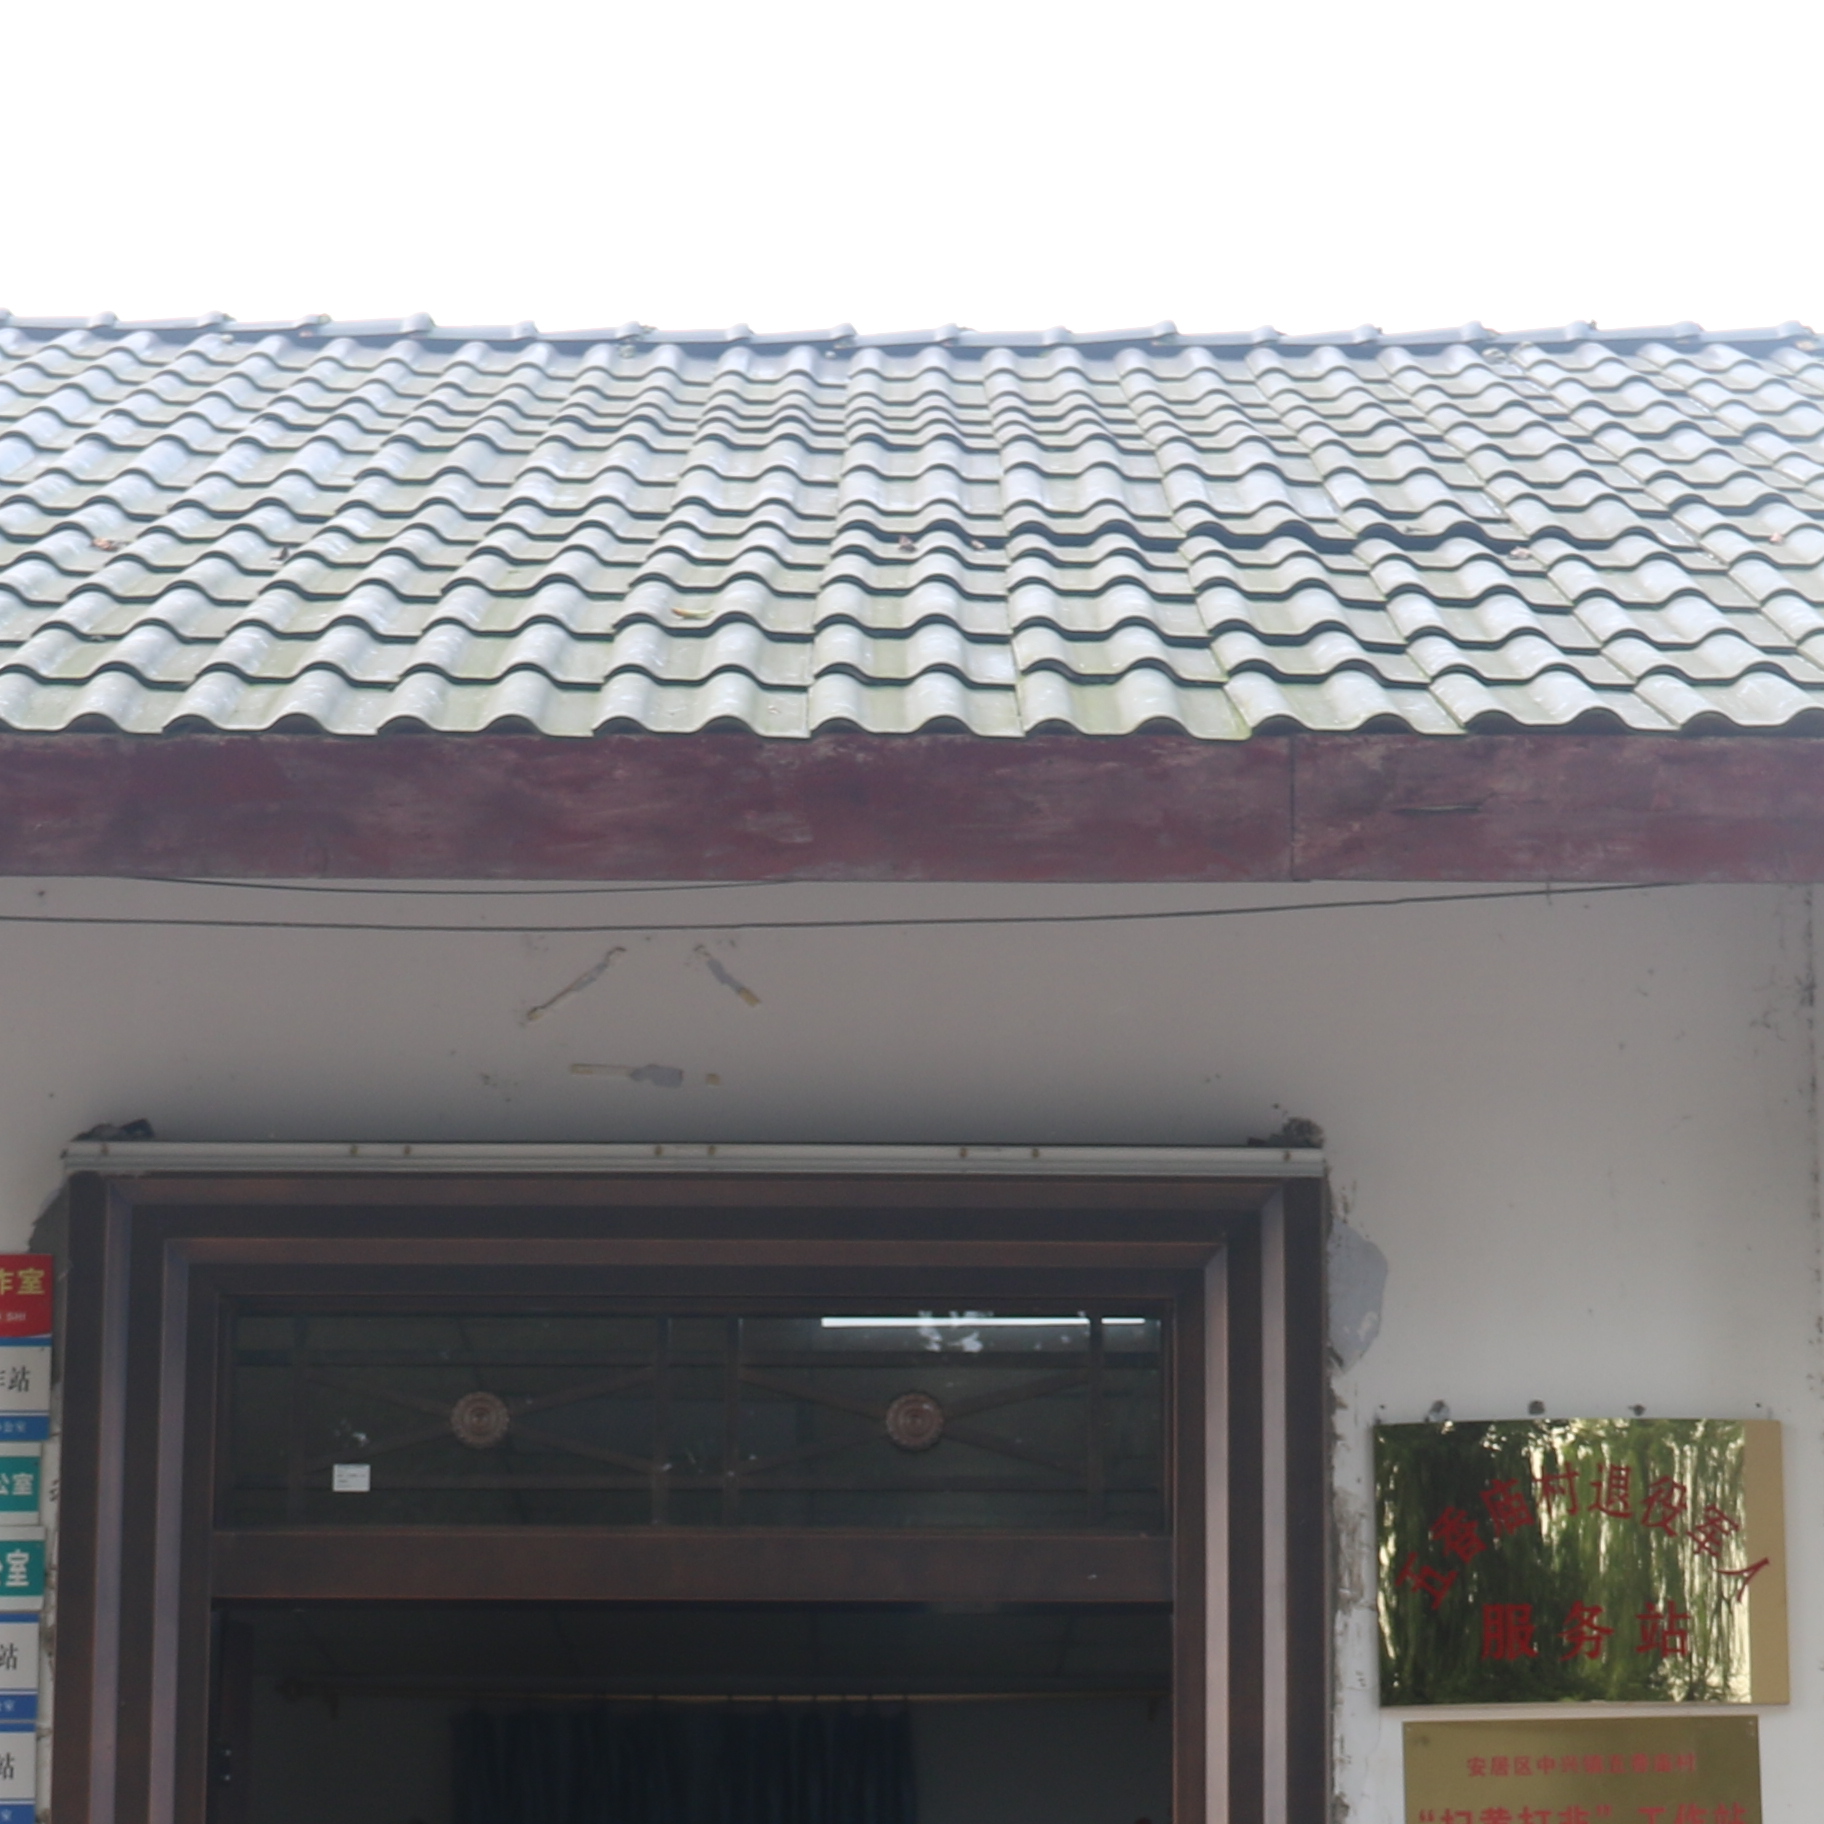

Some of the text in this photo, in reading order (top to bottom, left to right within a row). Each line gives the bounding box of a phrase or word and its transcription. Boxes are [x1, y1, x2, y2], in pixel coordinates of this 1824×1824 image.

[6, 1312, 26, 1322] SHI
[1394, 1461, 1770, 1610] 五香庙村退役军人
[1480, 1600, 1692, 1663] 服务站
